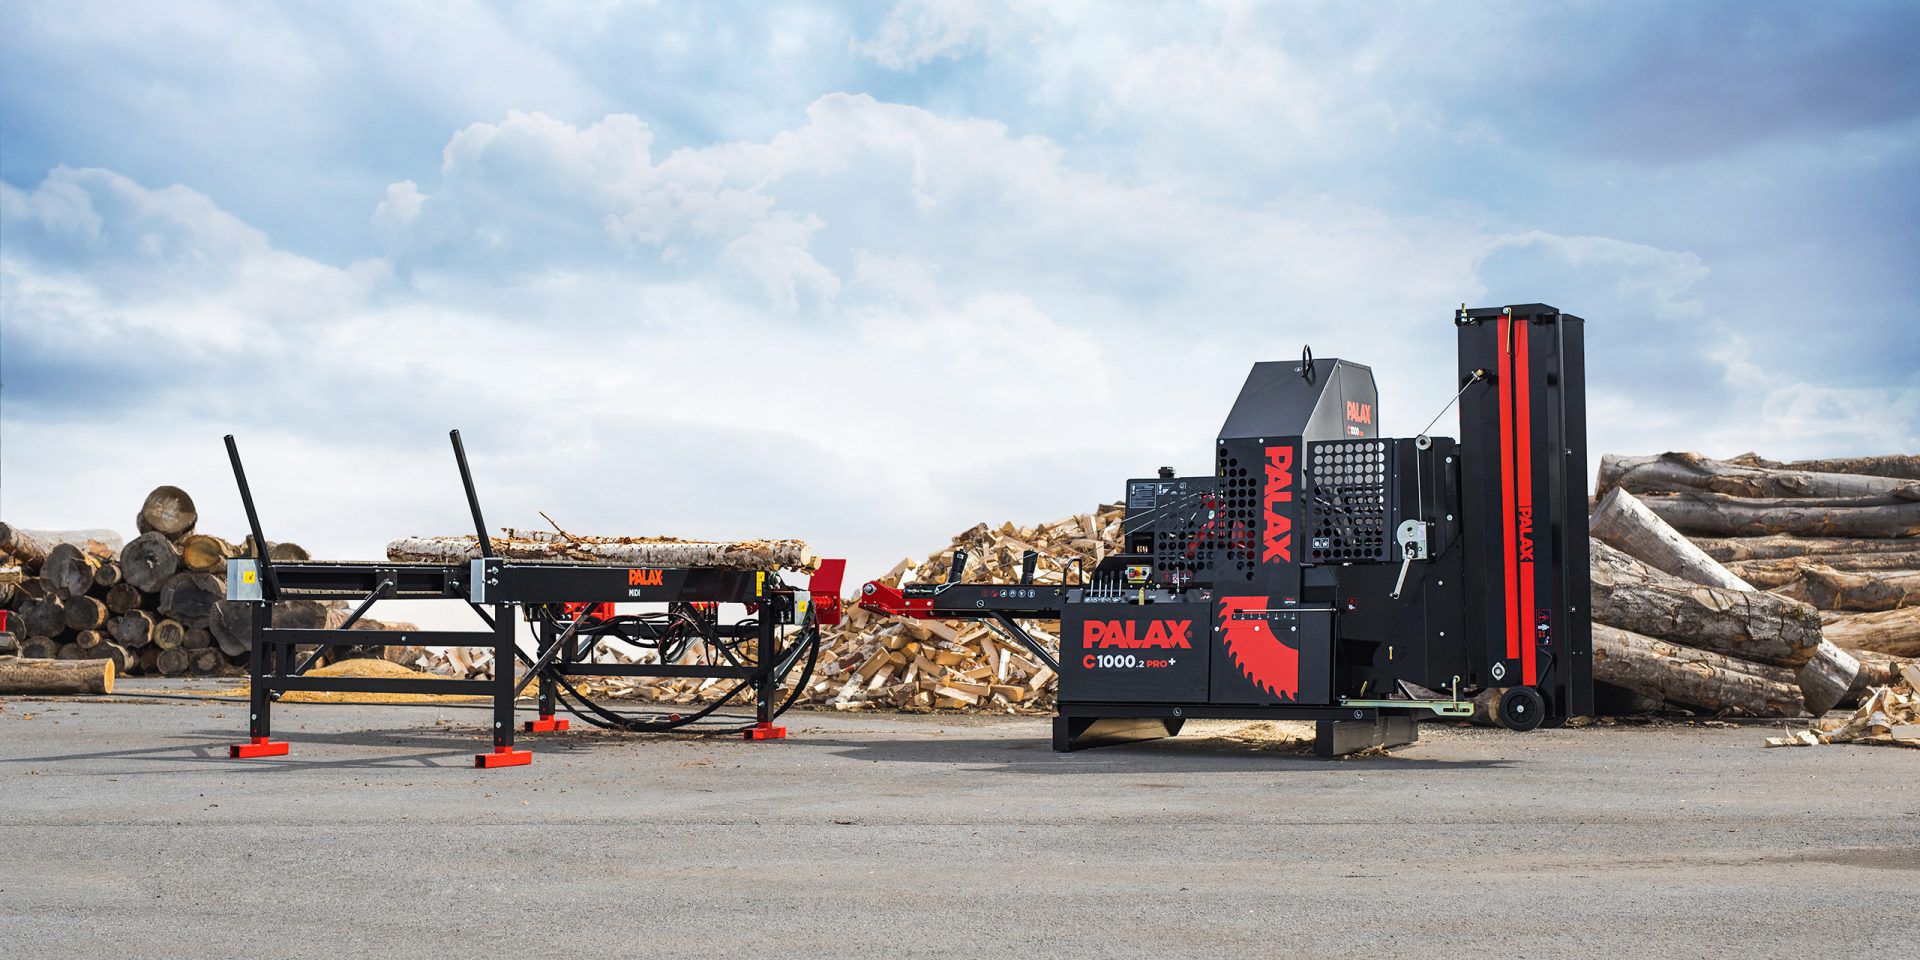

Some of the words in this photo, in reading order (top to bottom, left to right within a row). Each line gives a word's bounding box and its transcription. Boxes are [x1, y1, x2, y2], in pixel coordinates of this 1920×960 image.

[1346, 400, 1371, 425] PALAX
[1263, 446, 1293, 564] PALAX
[1519, 507, 1534, 561] PALAX
[629, 569, 663, 586] PALAX
